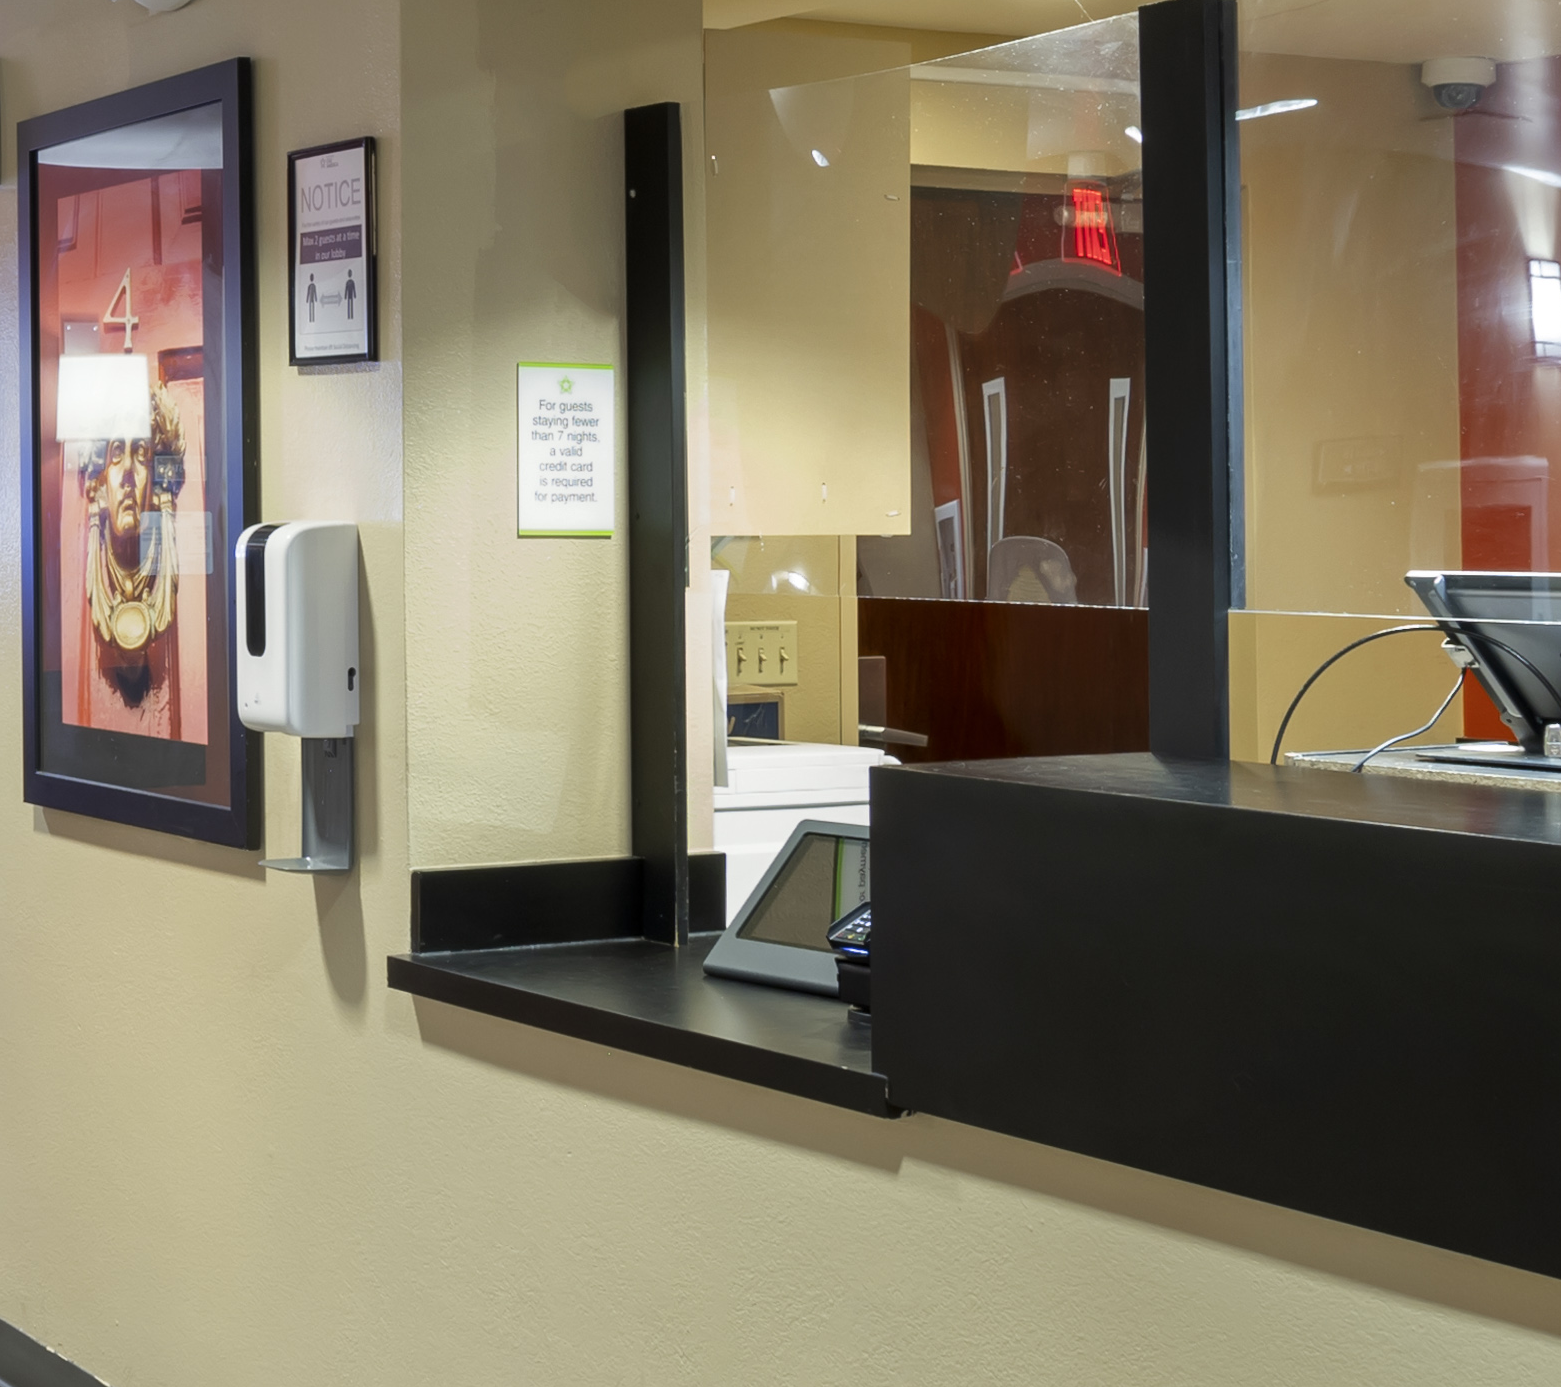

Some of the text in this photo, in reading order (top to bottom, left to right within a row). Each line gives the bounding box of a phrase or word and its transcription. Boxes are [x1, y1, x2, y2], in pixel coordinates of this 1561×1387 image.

[301, 178, 361, 213] NOTICE
[303, 236, 315, 247] Max
[319, 234, 335, 247] guests
[336, 233, 342, 242] at
[347, 231, 360, 241] time
[315, 248, 346, 261] in our lobby
[103, 267, 139, 348] 4
[539, 399, 593, 414] For guests
[533, 415, 599, 429] staying fewer
[531, 430, 600, 444] than 7 nights,
[550, 446, 583, 457] a valid
[539, 462, 593, 472] credit card
[539, 477, 593, 488] is required
[535, 491, 598, 504] for payment.
